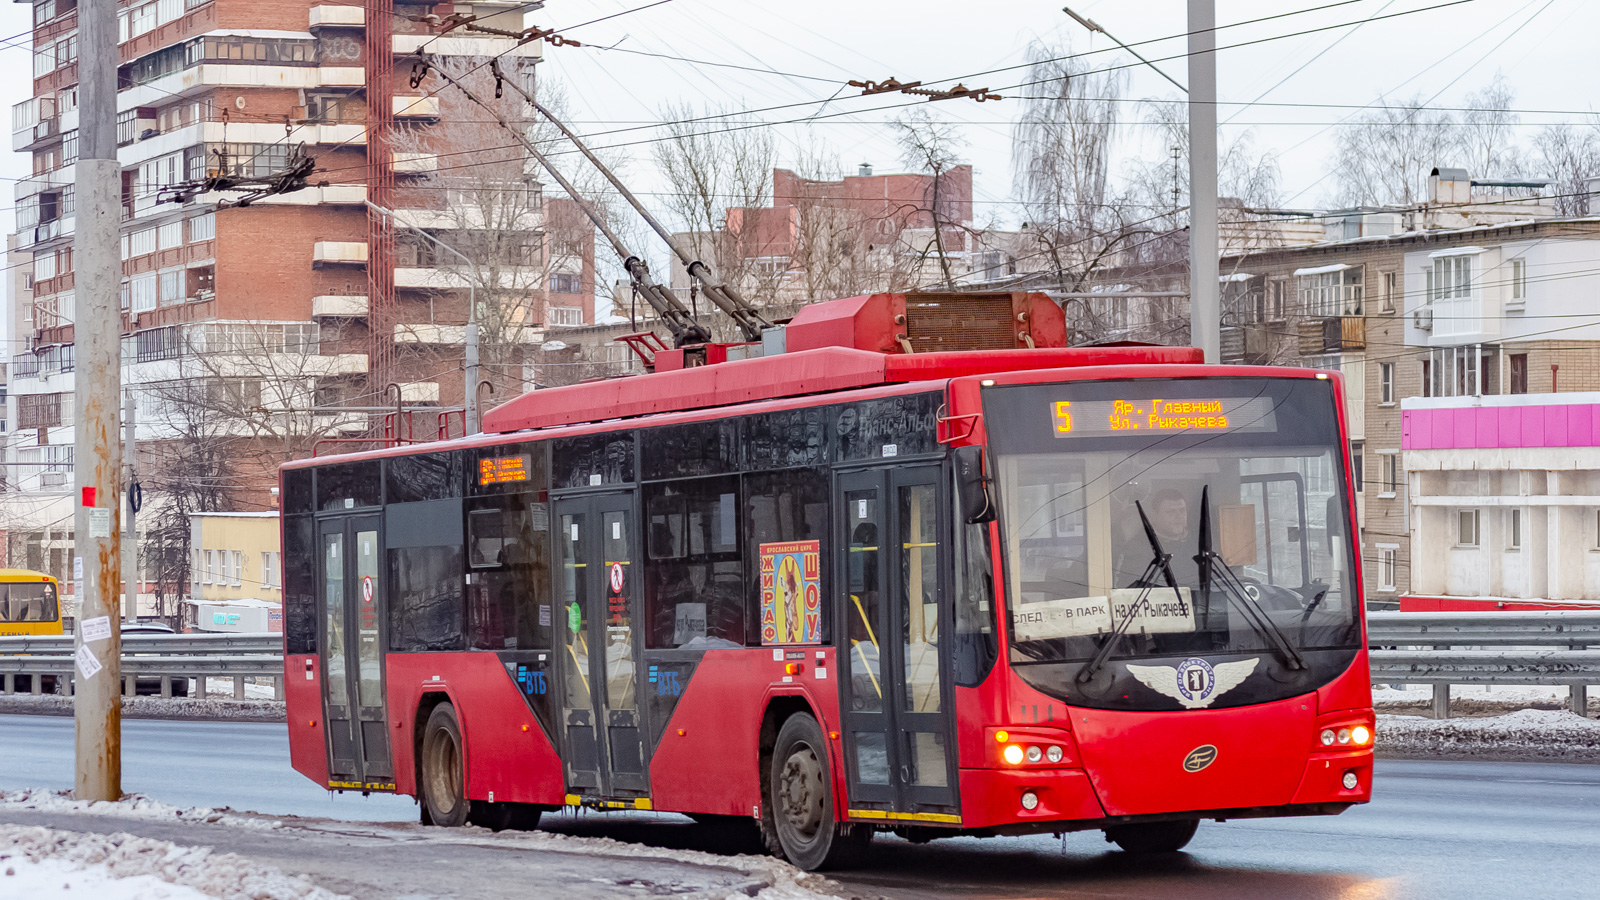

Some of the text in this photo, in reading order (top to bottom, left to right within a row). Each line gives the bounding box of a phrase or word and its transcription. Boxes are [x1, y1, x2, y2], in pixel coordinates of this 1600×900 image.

[1055, 401, 1072, 432] 5
[1113, 398, 1222, 415] Яр. Главный
[1109, 414, 1228, 430] Ул. Рыкачева
[766, 544, 812, 553] ЯРОСЛАВСКИЙ ЦИРК
[762, 555, 775, 641] ЖИРАФ
[804, 553, 819, 641] ШОУ
[1115, 604, 1127, 618] на
[1143, 598, 1190, 618] Рыкачева
[1065, 608, 1074, 618] В
[1076, 605, 1106, 617] ПАРК
[526, 671, 547, 694] ВТБ
[657, 671, 680, 695] ВТБ
[1177, 659, 1215, 700] ЯРГОРЭЛЕКТРОТРАНС
